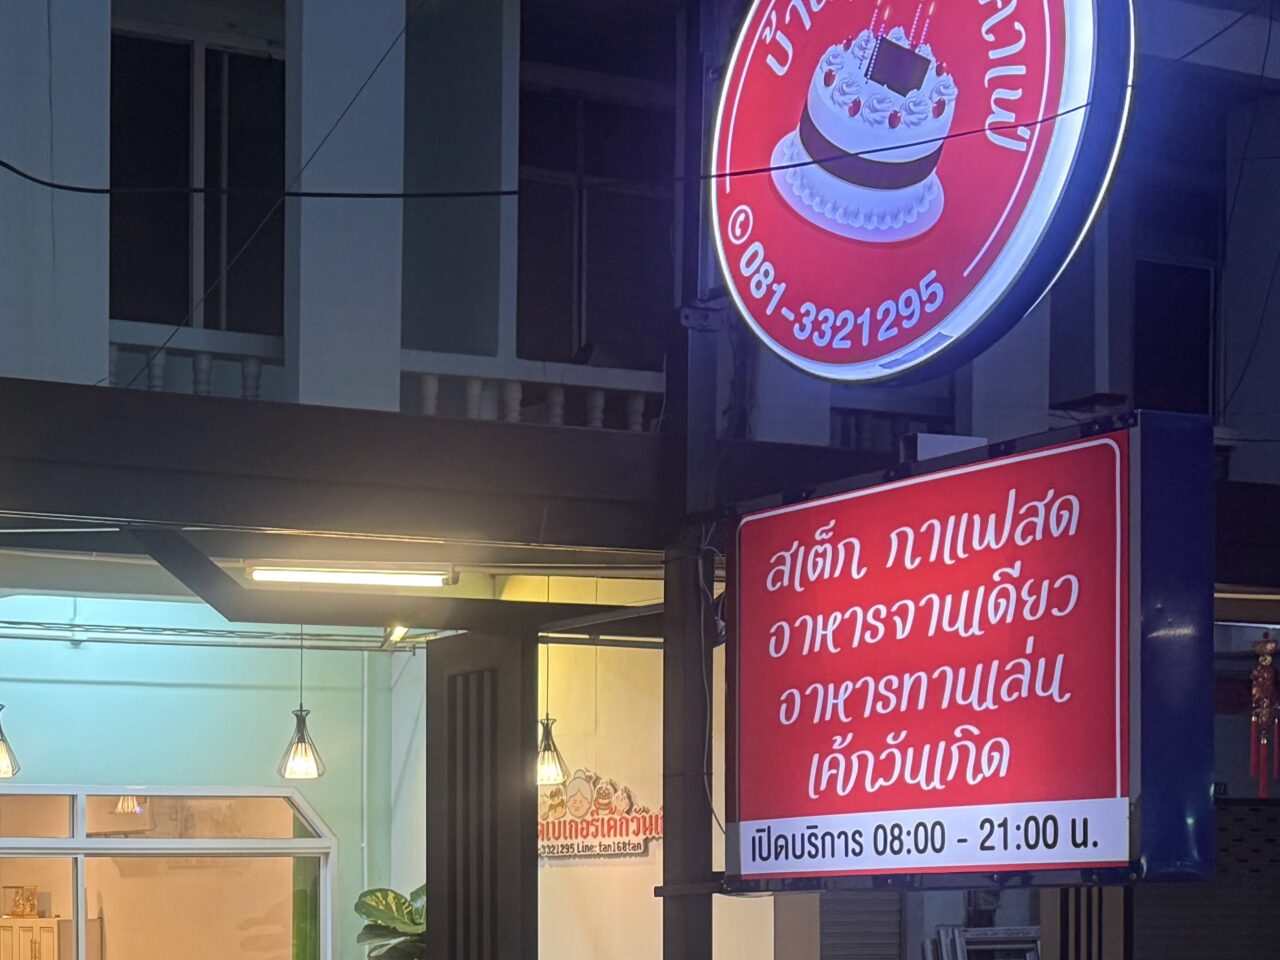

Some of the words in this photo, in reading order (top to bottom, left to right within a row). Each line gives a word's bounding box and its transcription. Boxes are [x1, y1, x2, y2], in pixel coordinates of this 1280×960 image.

[740, 241, 944, 349] 081-3321295
[766, 520, 867, 592] สเต็ก
[886, 489, 1081, 570] กาแฟสด
[769, 561, 1080, 658] อาหารจานเดียว
[779, 636, 1072, 725] อาหารทานเล่น
[808, 724, 1011, 799] เค้กวันเกิด
[750, 823, 864, 863] เปิดบริการ
[873, 821, 947, 856] 08:00
[979, 814, 1060, 853] 21:00
[1071, 816, 1099, 849] น.
